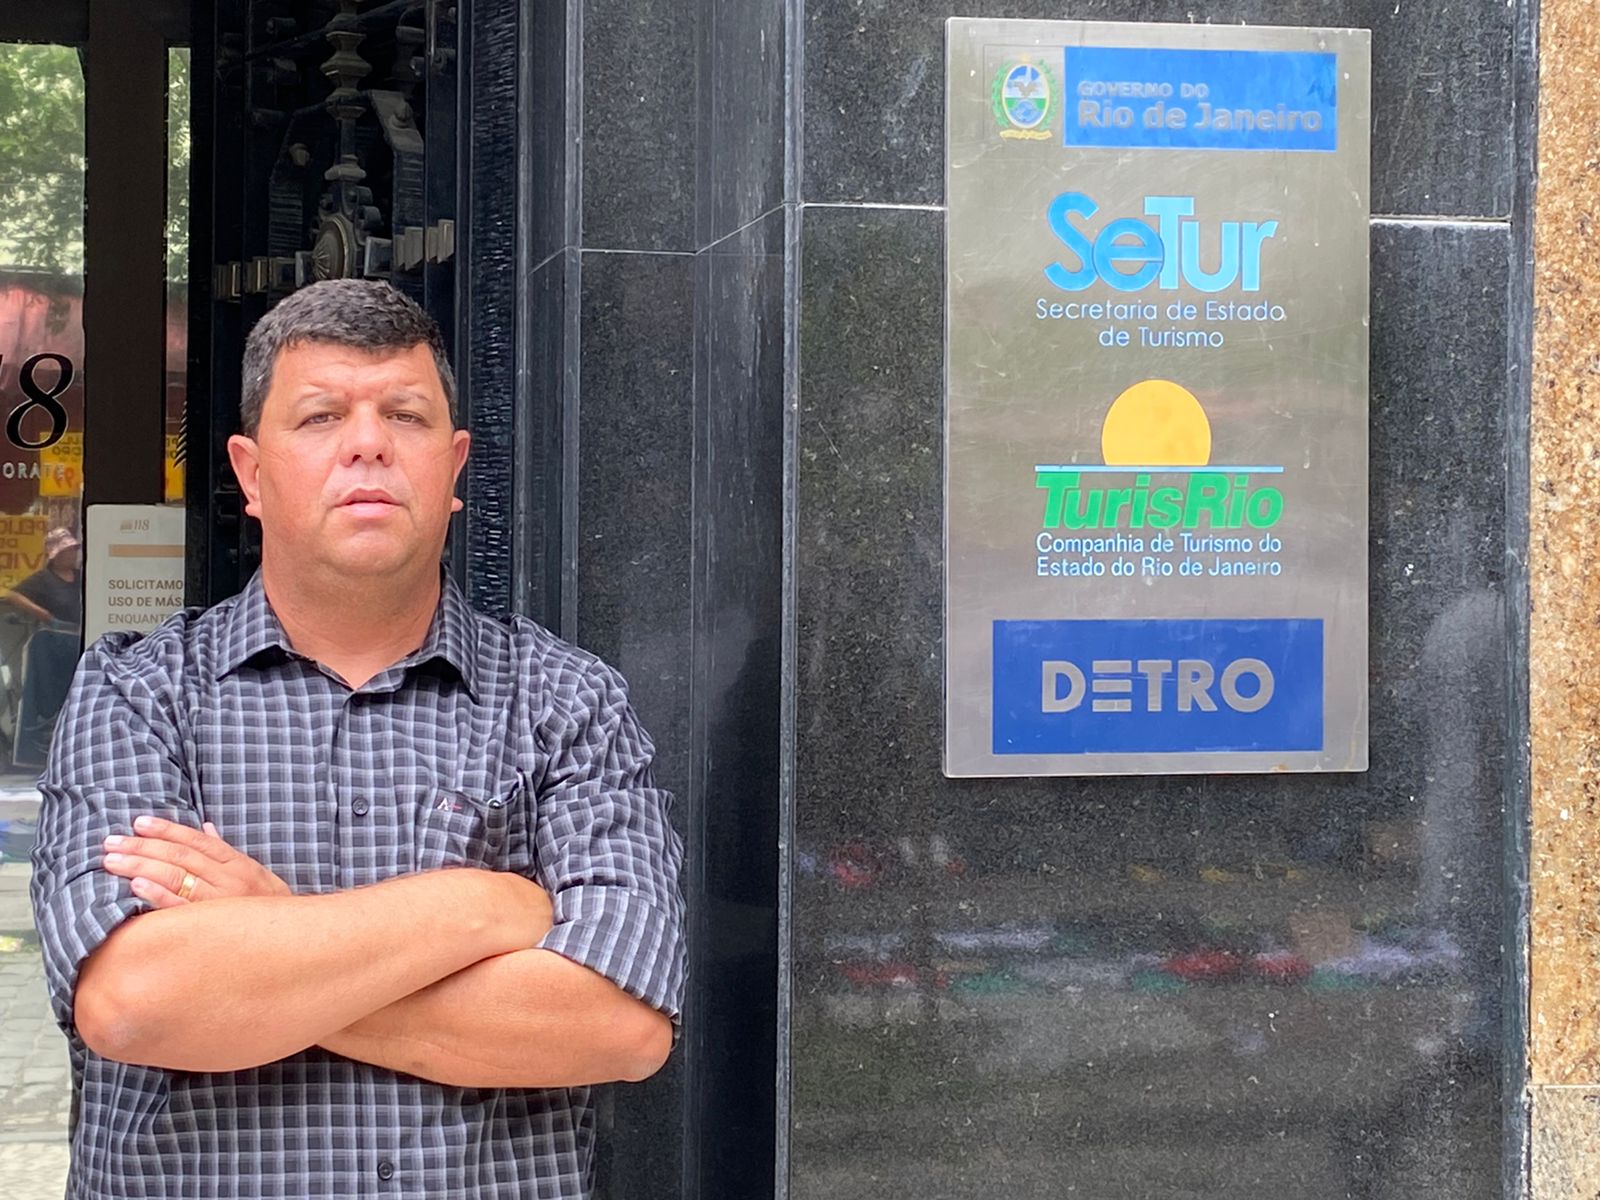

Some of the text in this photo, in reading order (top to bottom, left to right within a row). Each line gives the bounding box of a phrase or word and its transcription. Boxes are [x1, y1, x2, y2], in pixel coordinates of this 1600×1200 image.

[1077, 81, 1209, 98] GOVERNO DO
[1078, 100, 1322, 132] Rio de Janeiro
[1044, 191, 1279, 292] SeTur
[1036, 298, 1286, 322] Secretaria de Estado
[1099, 326, 1224, 348] de Turismo
[1035, 472, 1285, 530] TurisRio
[1036, 532, 1282, 557] Companhia de Turismo do
[1037, 557, 1282, 577] Estado do Rio de Janeiro
[108, 596, 133, 608] USO
[137, 597, 152, 608] DE
[1041, 658, 1275, 713] DETRO
